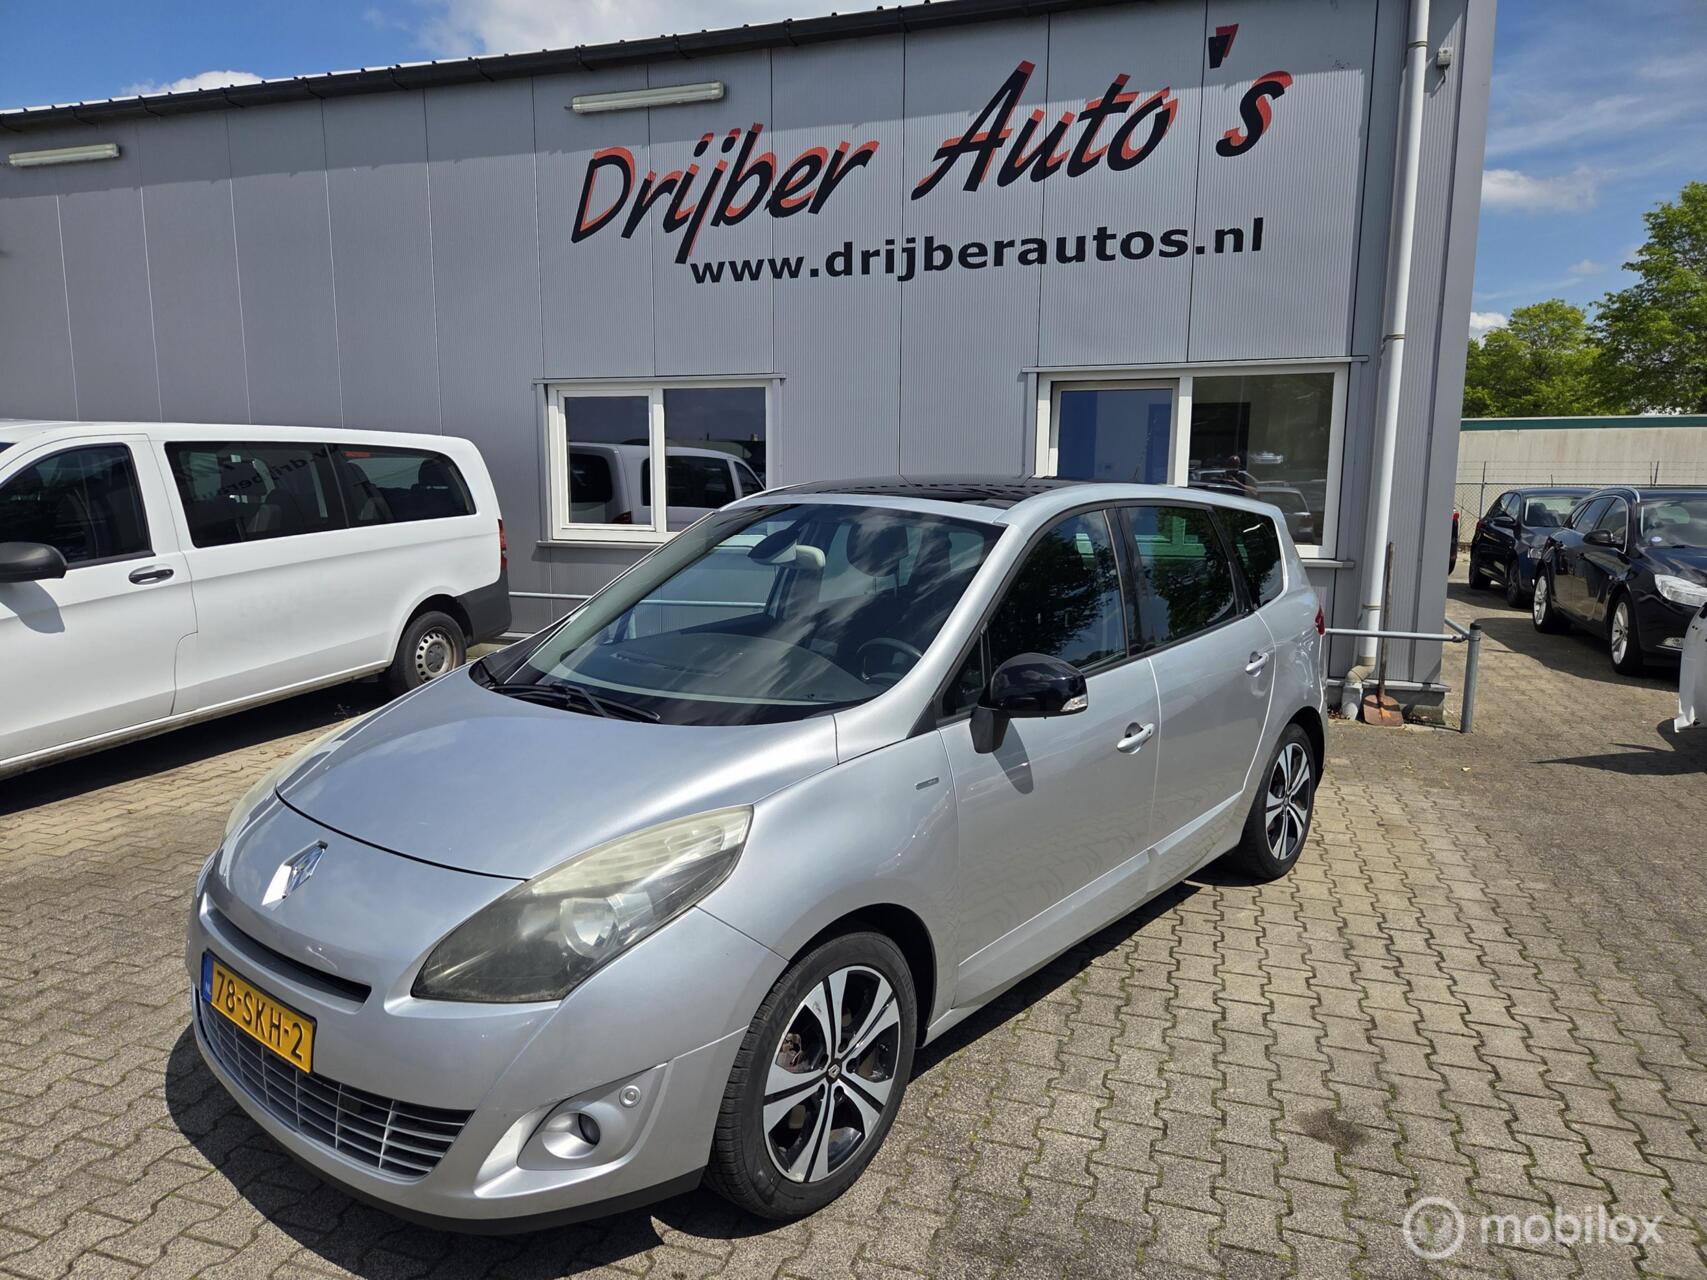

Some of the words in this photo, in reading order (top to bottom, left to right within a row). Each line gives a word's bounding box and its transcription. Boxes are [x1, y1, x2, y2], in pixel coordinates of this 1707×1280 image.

[571, 122, 880, 265] Drijber
[911, 24, 1294, 201] Auto's
[690, 217, 1264, 283] www.drijberautos.nl
[216, 970, 304, 1061] 78-SKH-2
